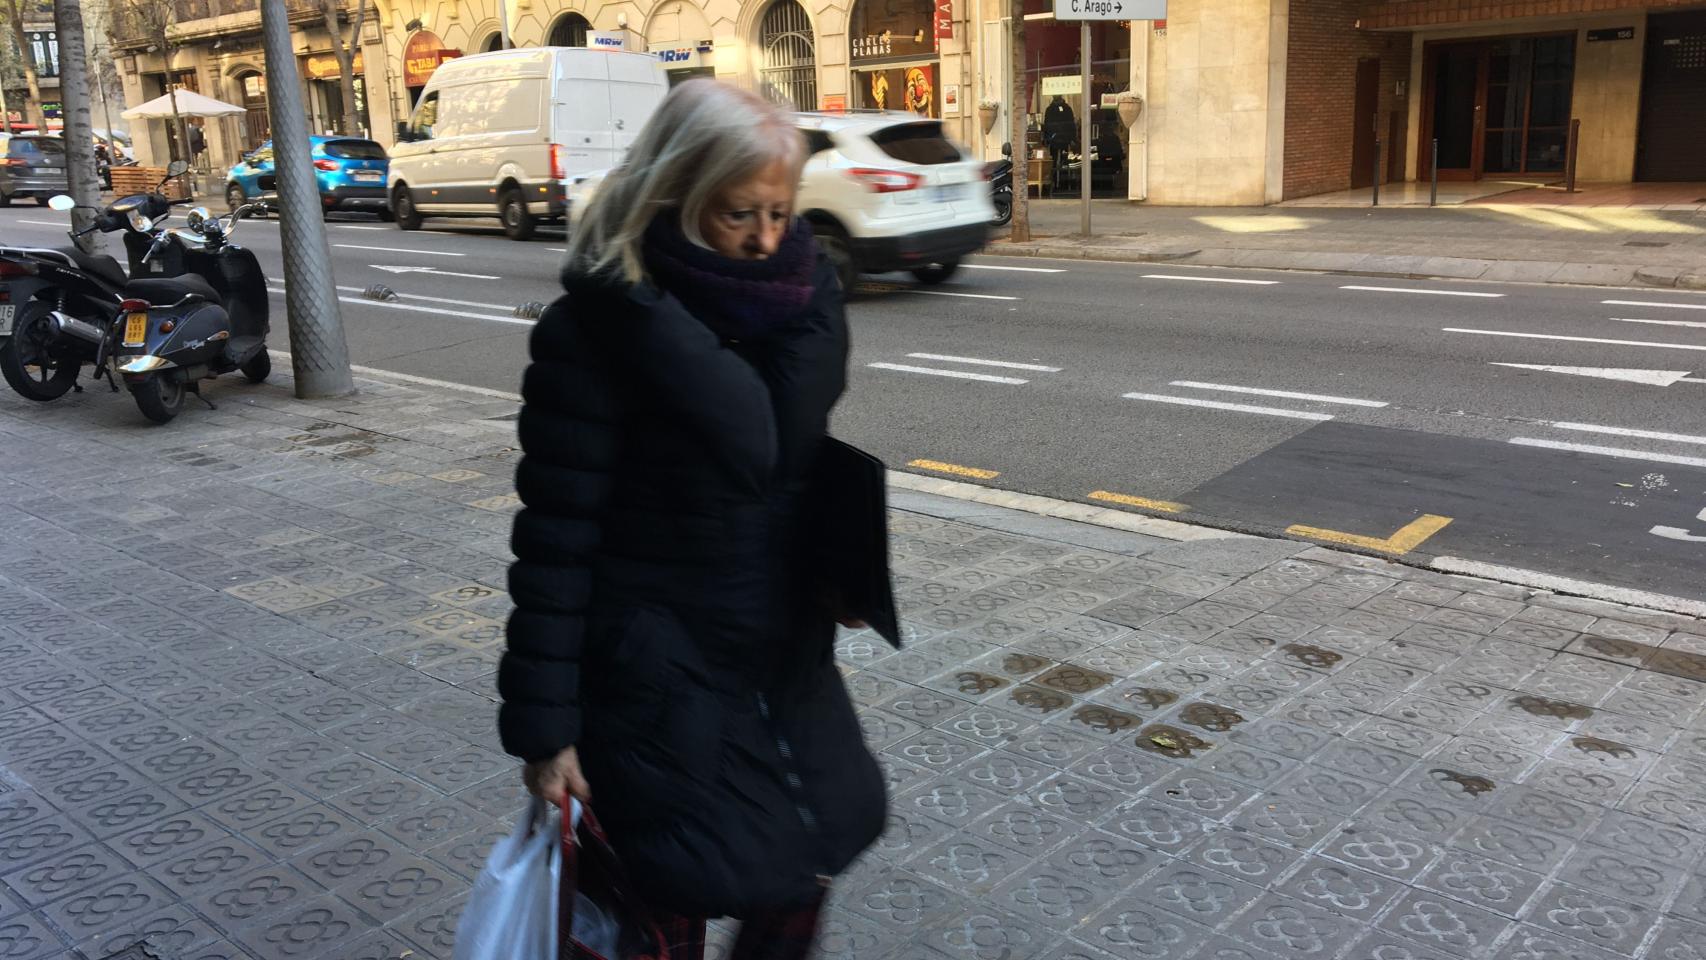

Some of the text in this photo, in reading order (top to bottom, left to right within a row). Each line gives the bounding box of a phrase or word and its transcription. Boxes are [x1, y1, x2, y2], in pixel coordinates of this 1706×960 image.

[1071, 0, 1112, 15] C. Aragó
[1617, 30, 1632, 39] 156
[594, 37, 624, 46] MRW
[852, 45, 892, 57] PLANAS
